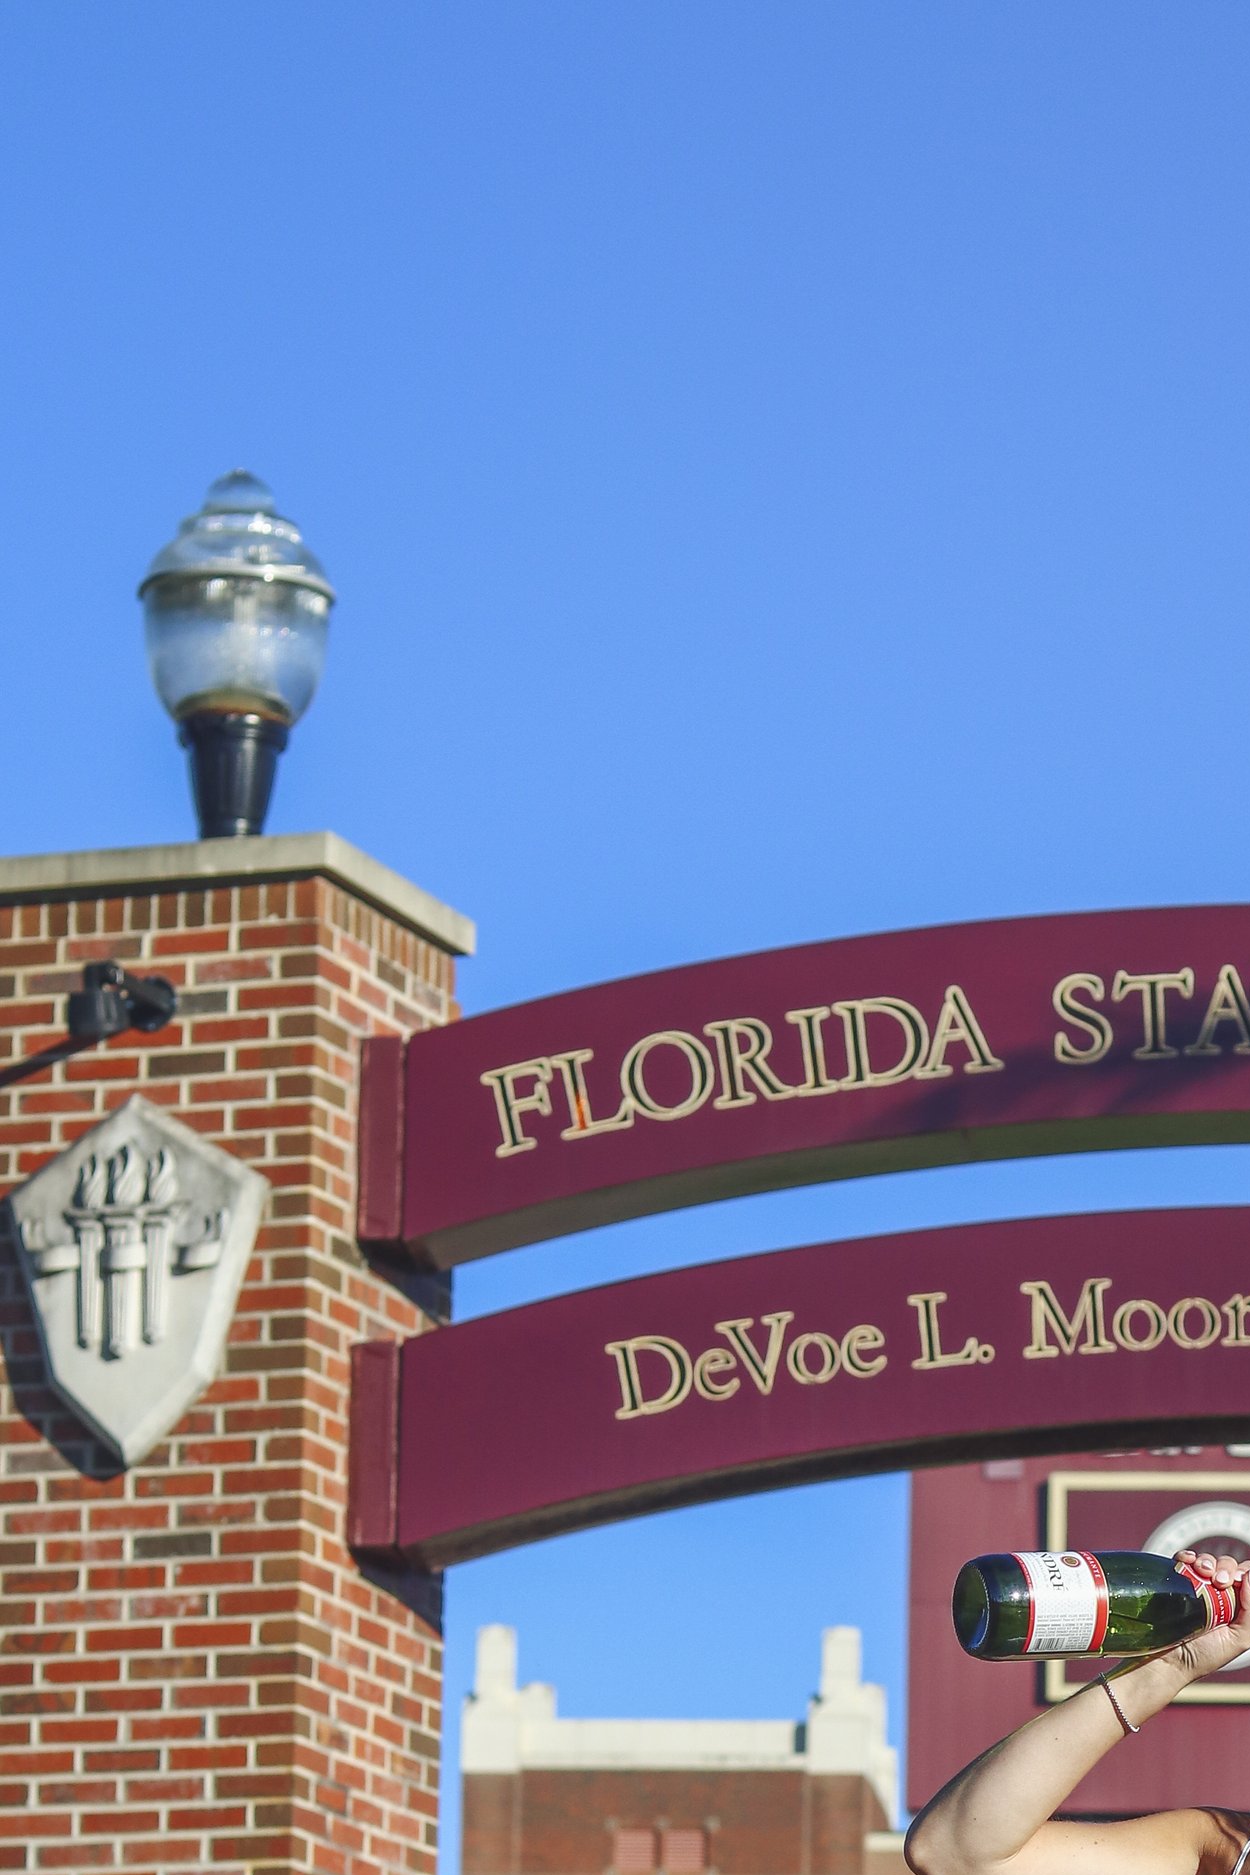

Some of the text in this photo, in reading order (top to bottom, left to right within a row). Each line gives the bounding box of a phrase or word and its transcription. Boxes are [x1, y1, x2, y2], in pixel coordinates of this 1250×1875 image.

[481, 984, 1004, 1158] FLORIDA
[604, 1311, 887, 1420] DeVoe
[907, 1291, 995, 1371] L.
[1040, 1552, 1068, 1592] NDRÉ
